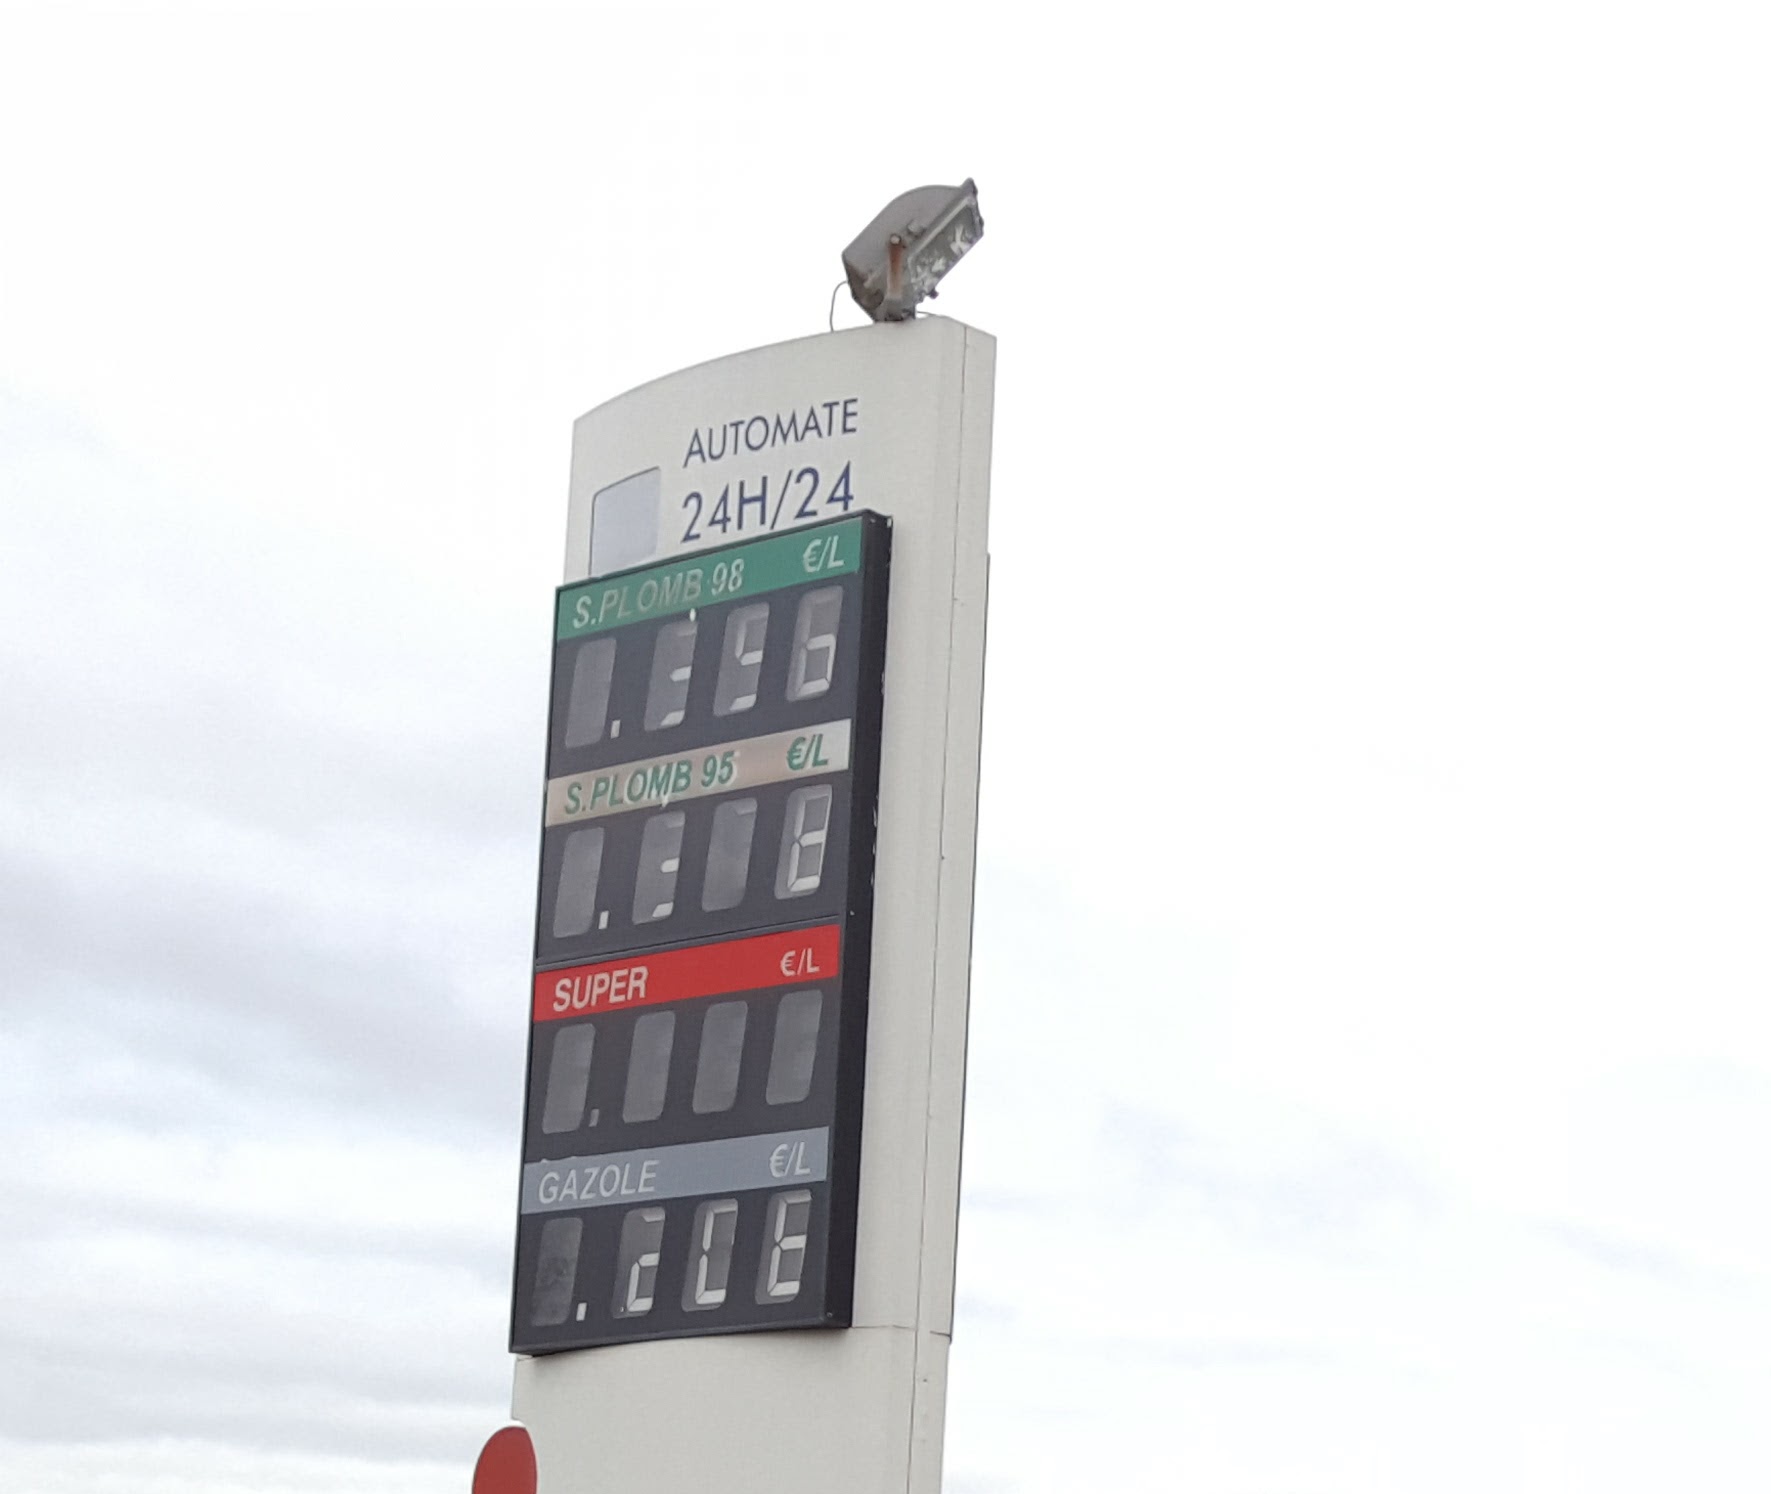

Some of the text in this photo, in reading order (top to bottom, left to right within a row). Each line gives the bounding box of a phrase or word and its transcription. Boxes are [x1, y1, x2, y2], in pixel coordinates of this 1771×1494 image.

[683, 398, 858, 469] AUTOMATE
[680, 460, 854, 544] 24H/24
[710, 558, 746, 596] 98
[802, 534, 844, 573] €/L
[564, 733, 829, 815] S.PLOMB 95 €/L
[553, 947, 820, 1012] SUPER €/L
[538, 1141, 811, 1204] GAZOLE €/L
